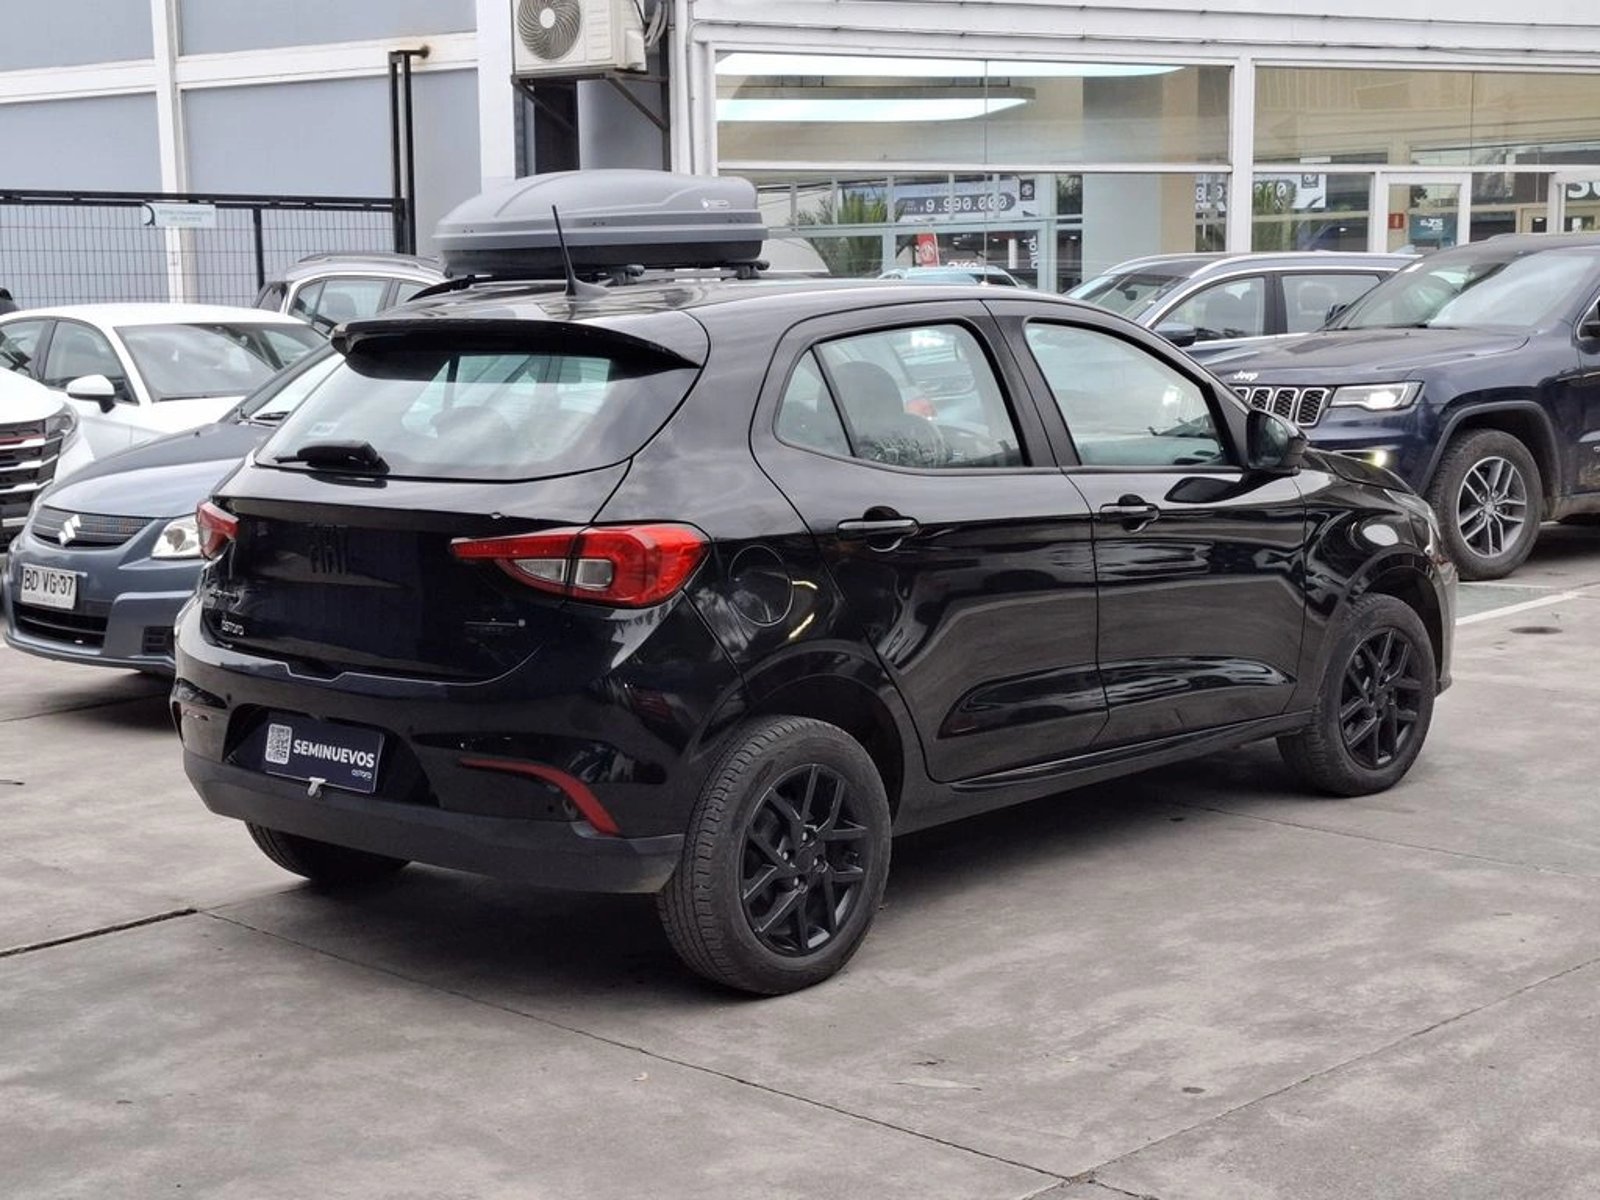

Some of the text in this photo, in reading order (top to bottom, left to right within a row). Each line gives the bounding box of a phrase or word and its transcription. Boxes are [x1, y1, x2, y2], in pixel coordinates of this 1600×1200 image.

[1233, 370, 1259, 382] Jeep
[24, 569, 39, 591] BD
[293, 739, 375, 768] SEMINUEVOS
